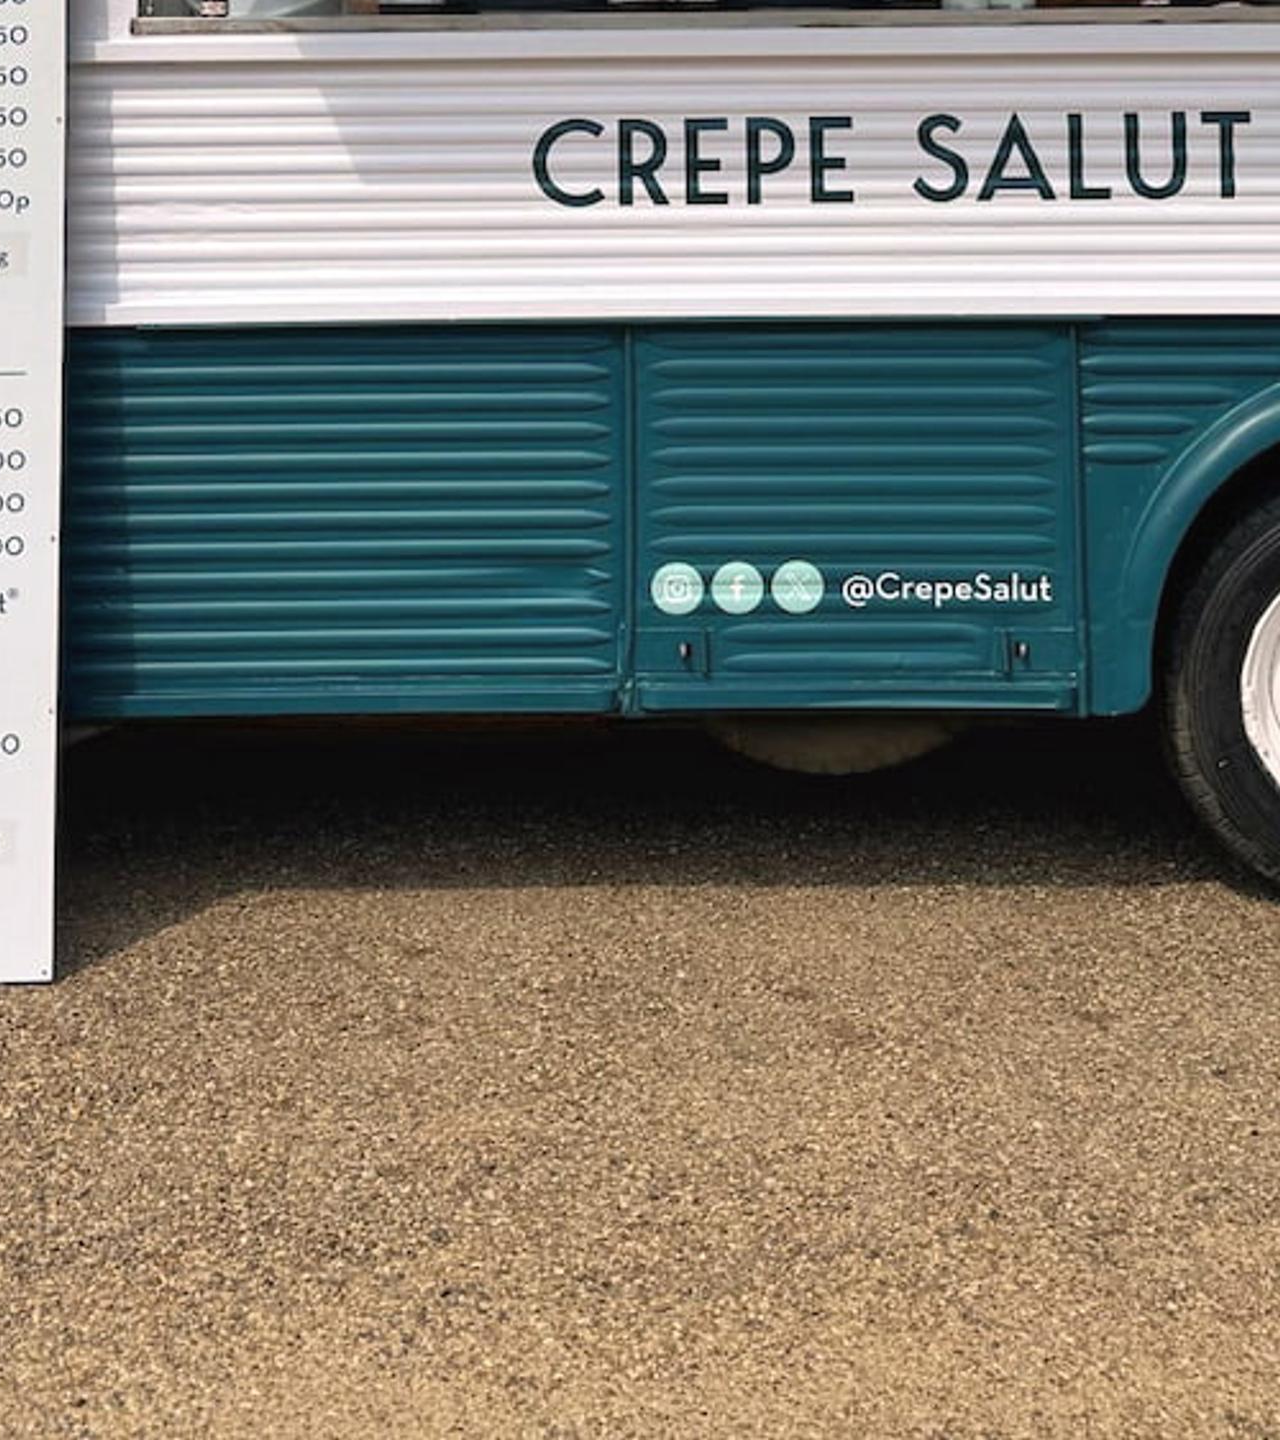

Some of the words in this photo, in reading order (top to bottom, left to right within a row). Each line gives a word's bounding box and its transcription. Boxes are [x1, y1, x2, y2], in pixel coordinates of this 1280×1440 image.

[531, 111, 855, 208] CREPE
[912, 109, 1252, 203] SALUT
[842, 572, 1052, 608] @CrepeSalut
